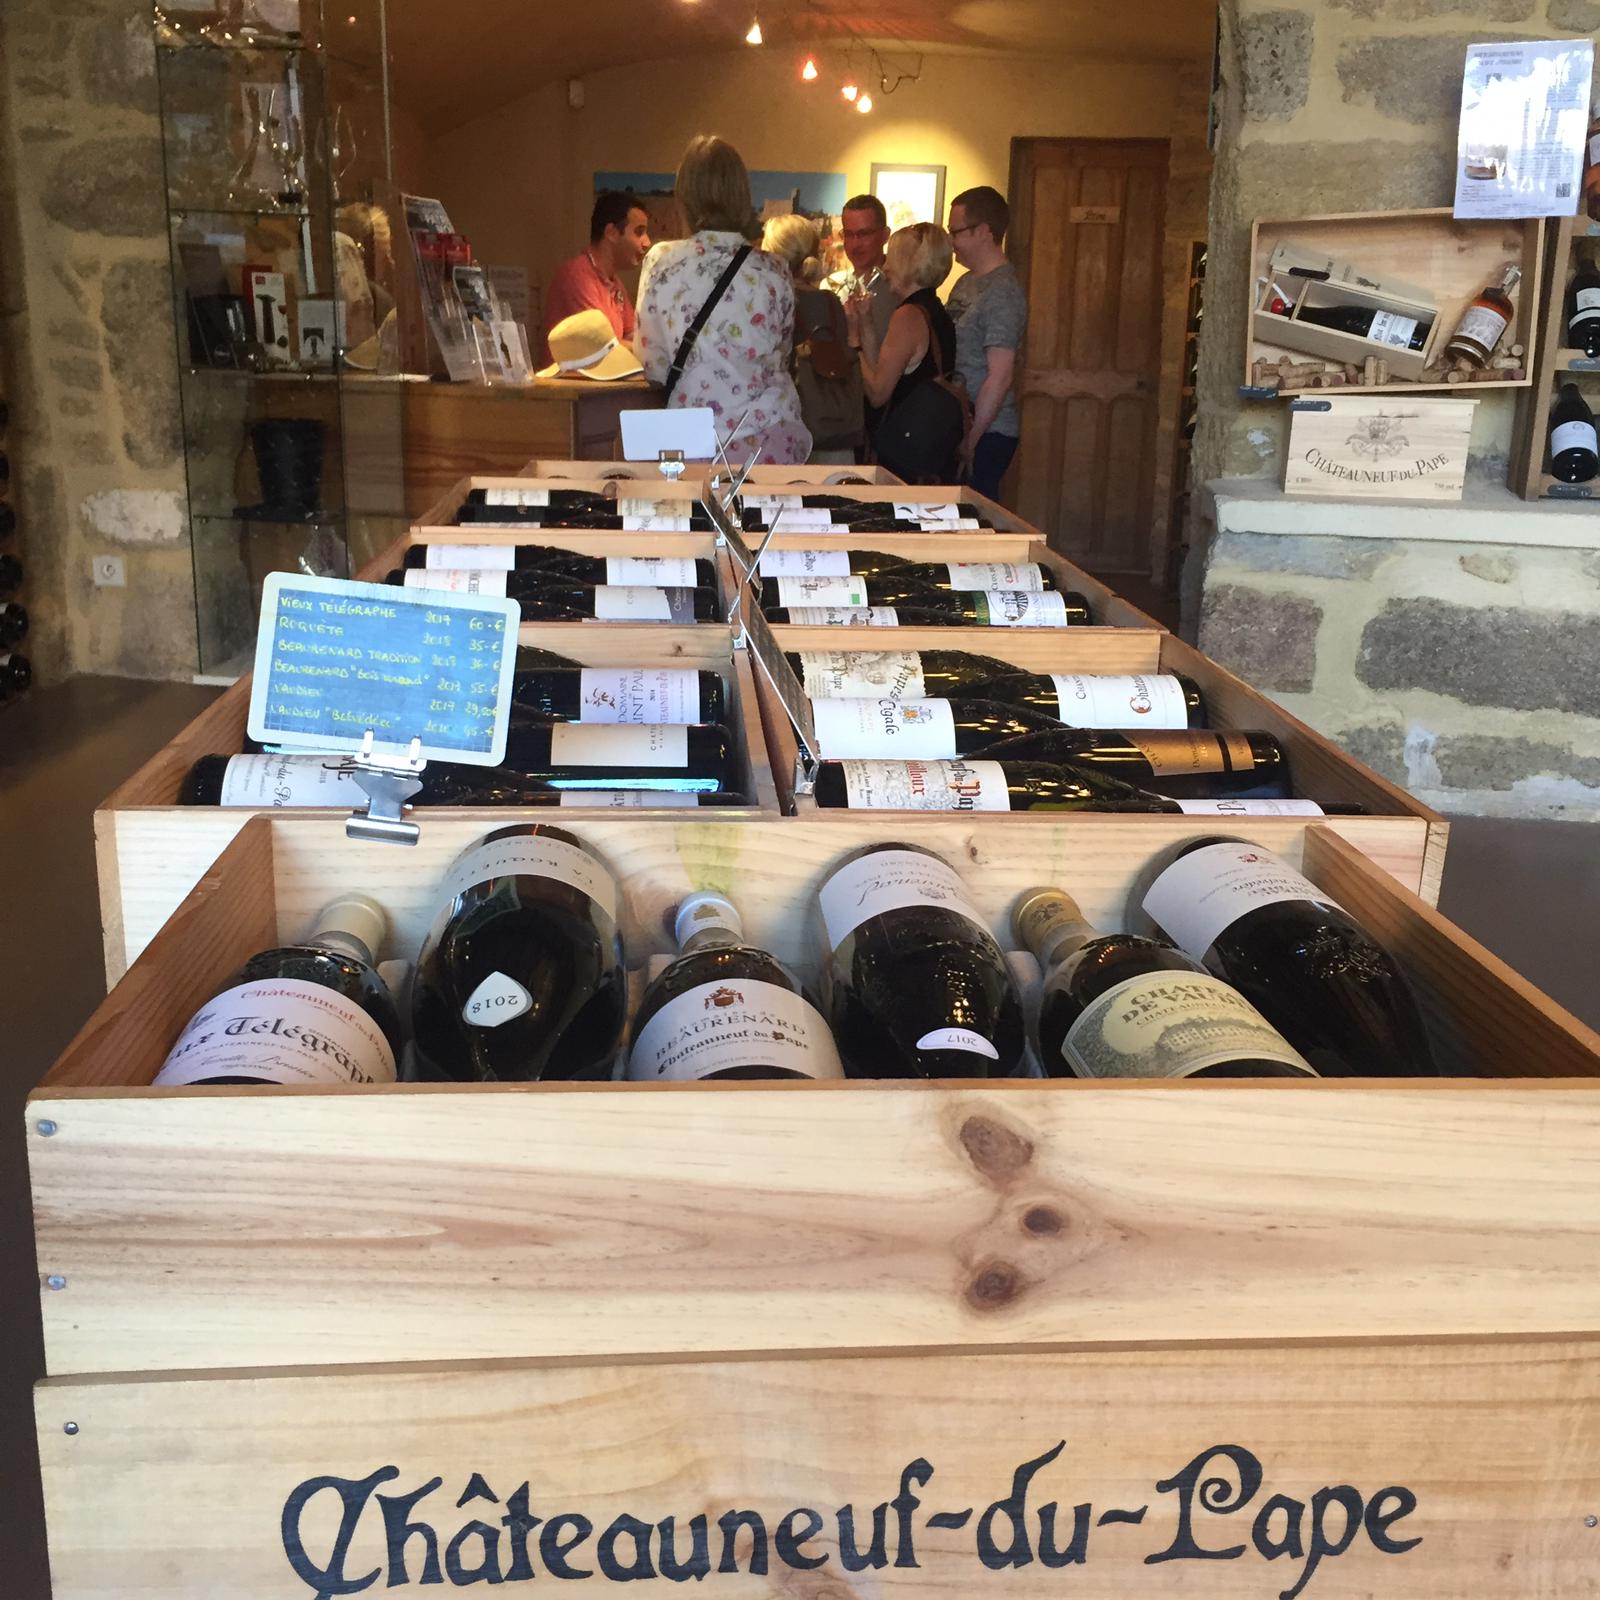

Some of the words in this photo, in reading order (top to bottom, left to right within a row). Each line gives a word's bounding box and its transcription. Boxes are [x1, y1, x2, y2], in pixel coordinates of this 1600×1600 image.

[1415, 453, 1450, 476] PAPE
[319, 598, 397, 618] TÉLÉGRAPHE
[877, 699, 902, 736] Cigale
[472, 995, 518, 1014] 2018
[1121, 1000, 1158, 1024] DE
[655, 1014, 807, 1061] BEAURENARD
[947, 1034, 977, 1047] 2017
